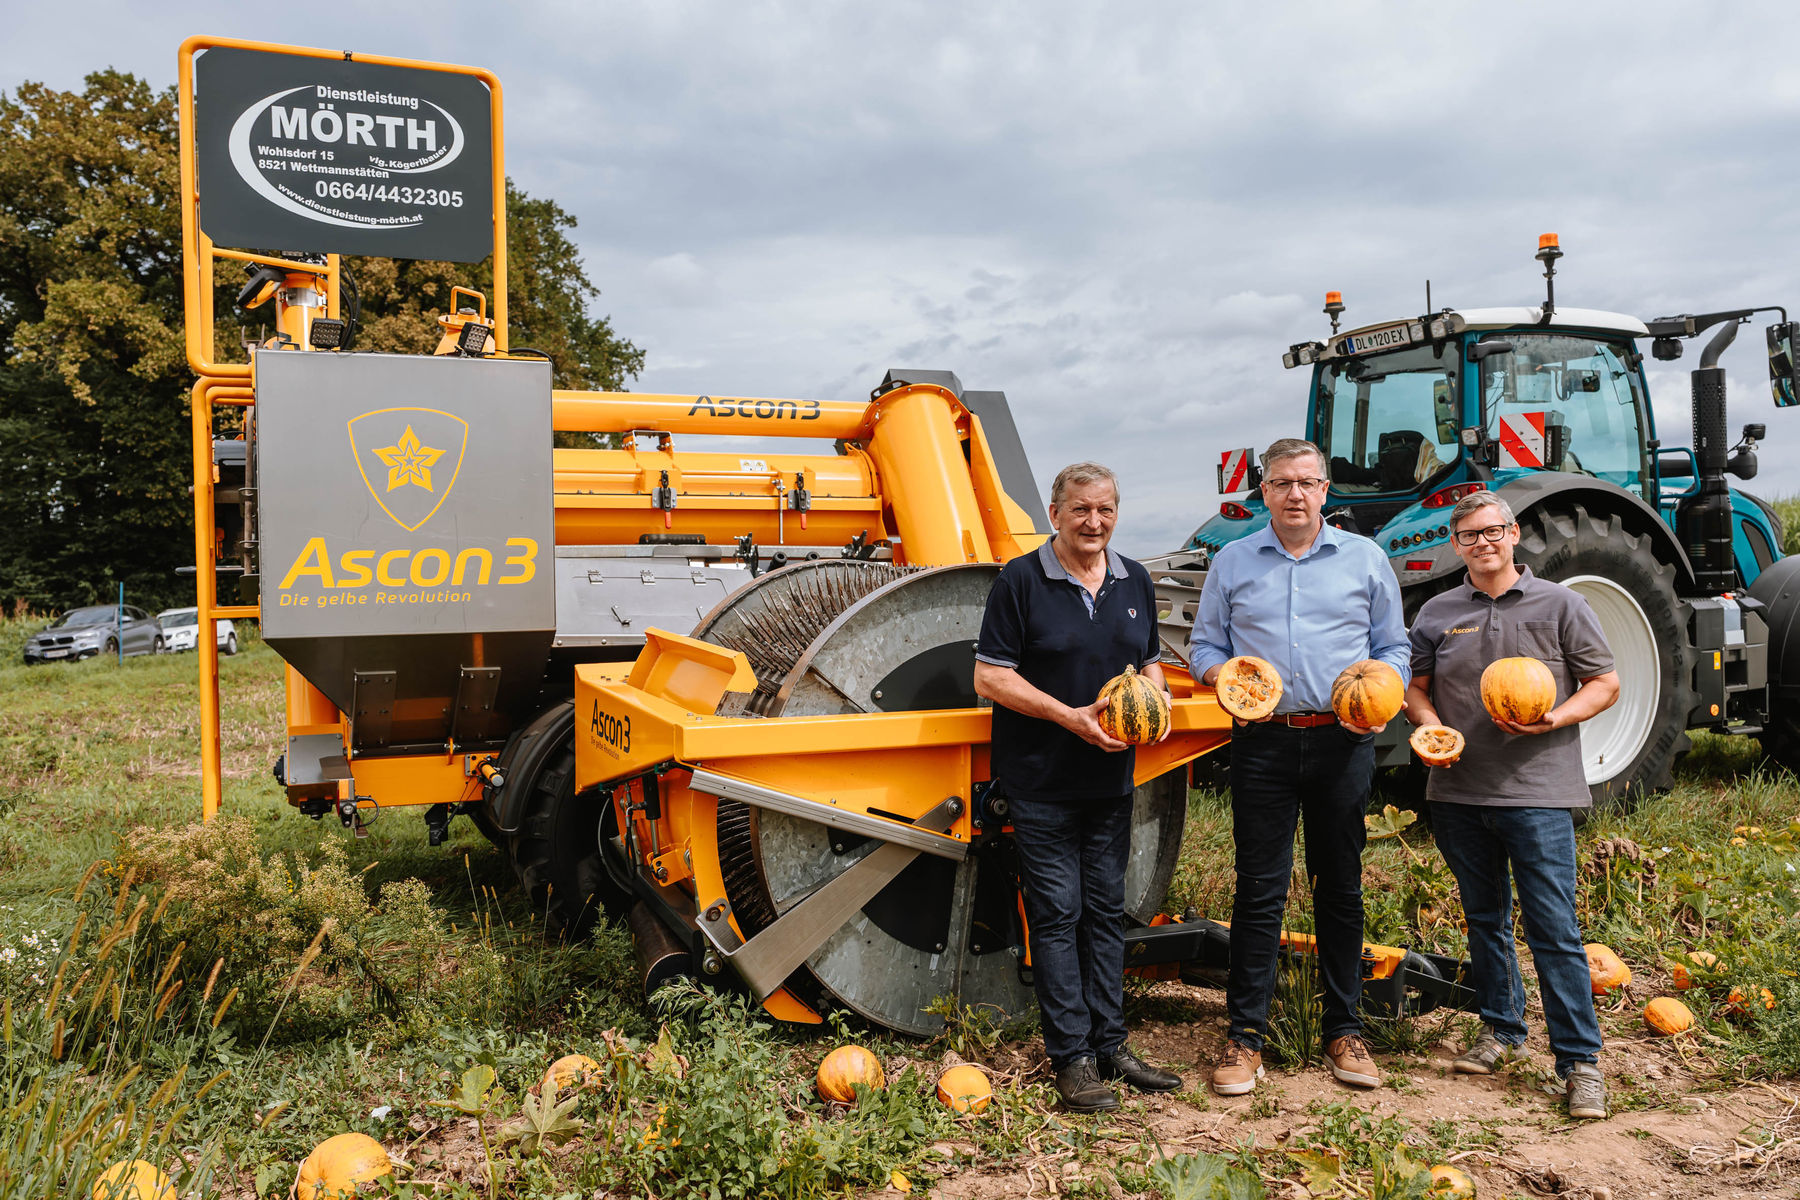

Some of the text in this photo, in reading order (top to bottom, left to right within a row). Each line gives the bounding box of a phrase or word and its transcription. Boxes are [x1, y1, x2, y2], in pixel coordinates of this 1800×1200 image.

[316, 85, 419, 110] Dienstleistung
[271, 102, 437, 152] MÖRTH
[258, 145, 334, 161] Wohlsdorf 15
[258, 159, 390, 179] 8521 Wettmannstätten
[277, 183, 424, 225] www.dienstleistung-mörth.at
[315, 180, 464, 208] 0664/4432305
[1355, 338, 1368, 350] DL
[279, 590, 471, 608] Die gelbe Revolution
